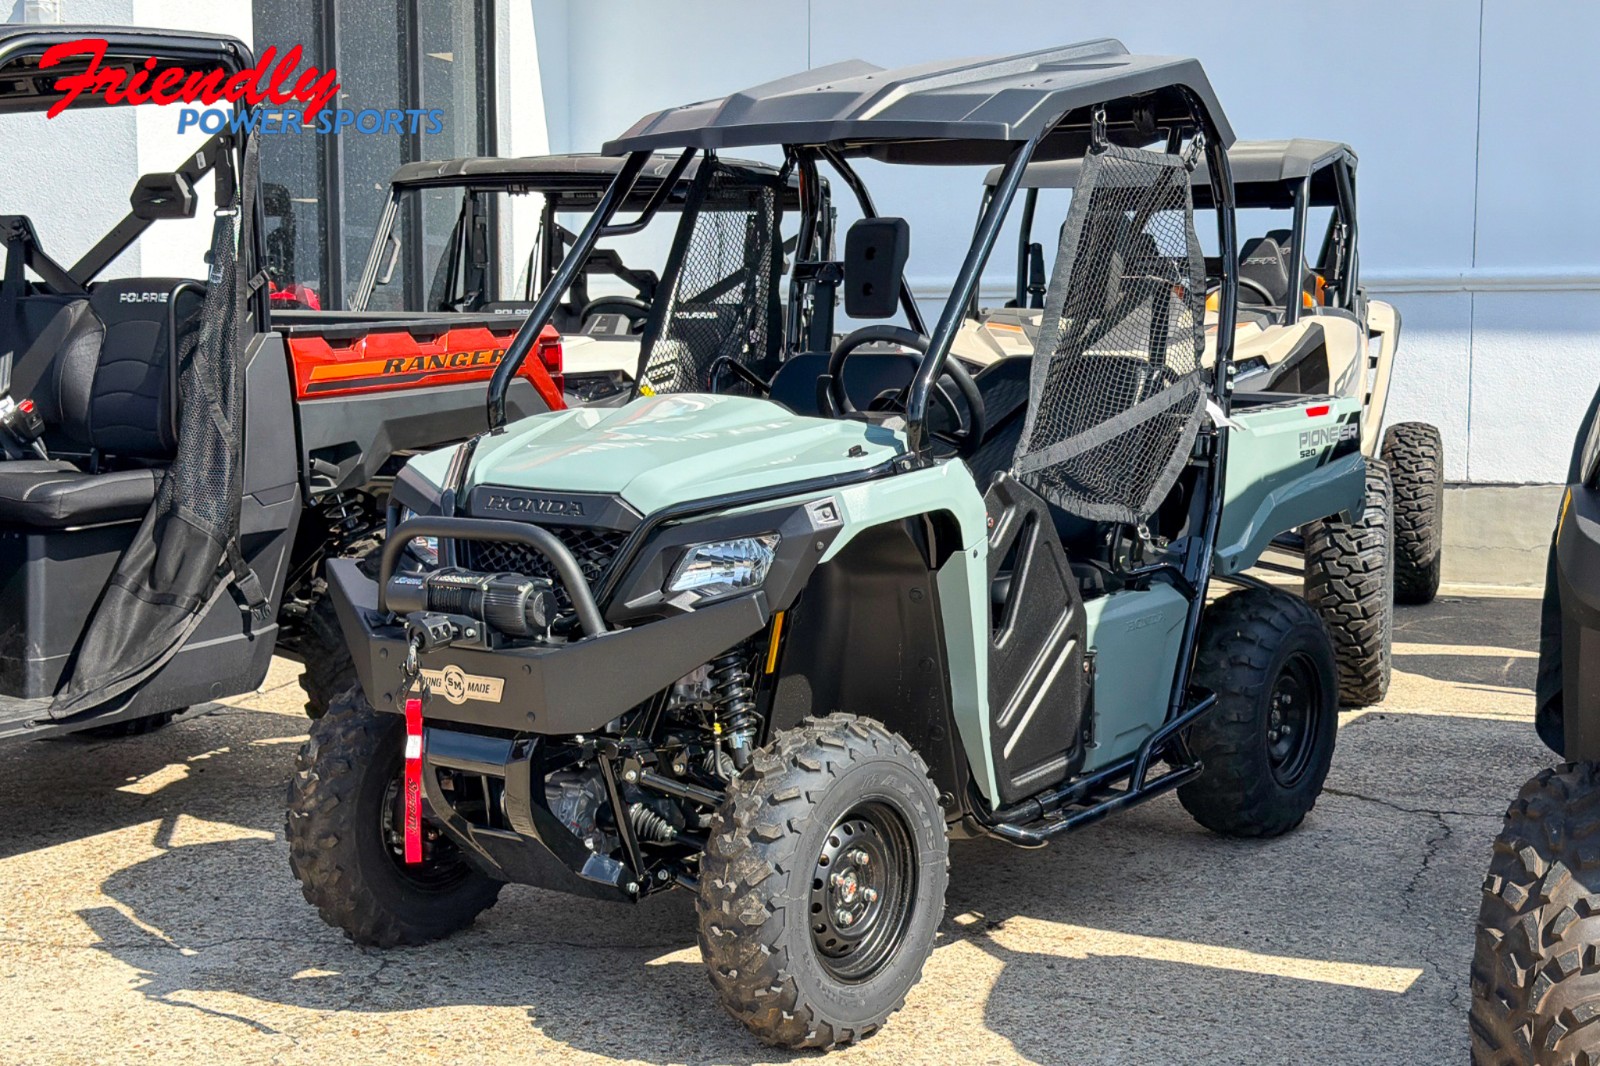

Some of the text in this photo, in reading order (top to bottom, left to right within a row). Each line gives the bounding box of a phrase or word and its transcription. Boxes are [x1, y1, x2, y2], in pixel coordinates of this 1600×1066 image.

[1299, 422, 1358, 449] PIONEER
[1300, 448, 1316, 458] 520
[484, 495, 585, 517] HONDA
[467, 682, 491, 694] MADE
